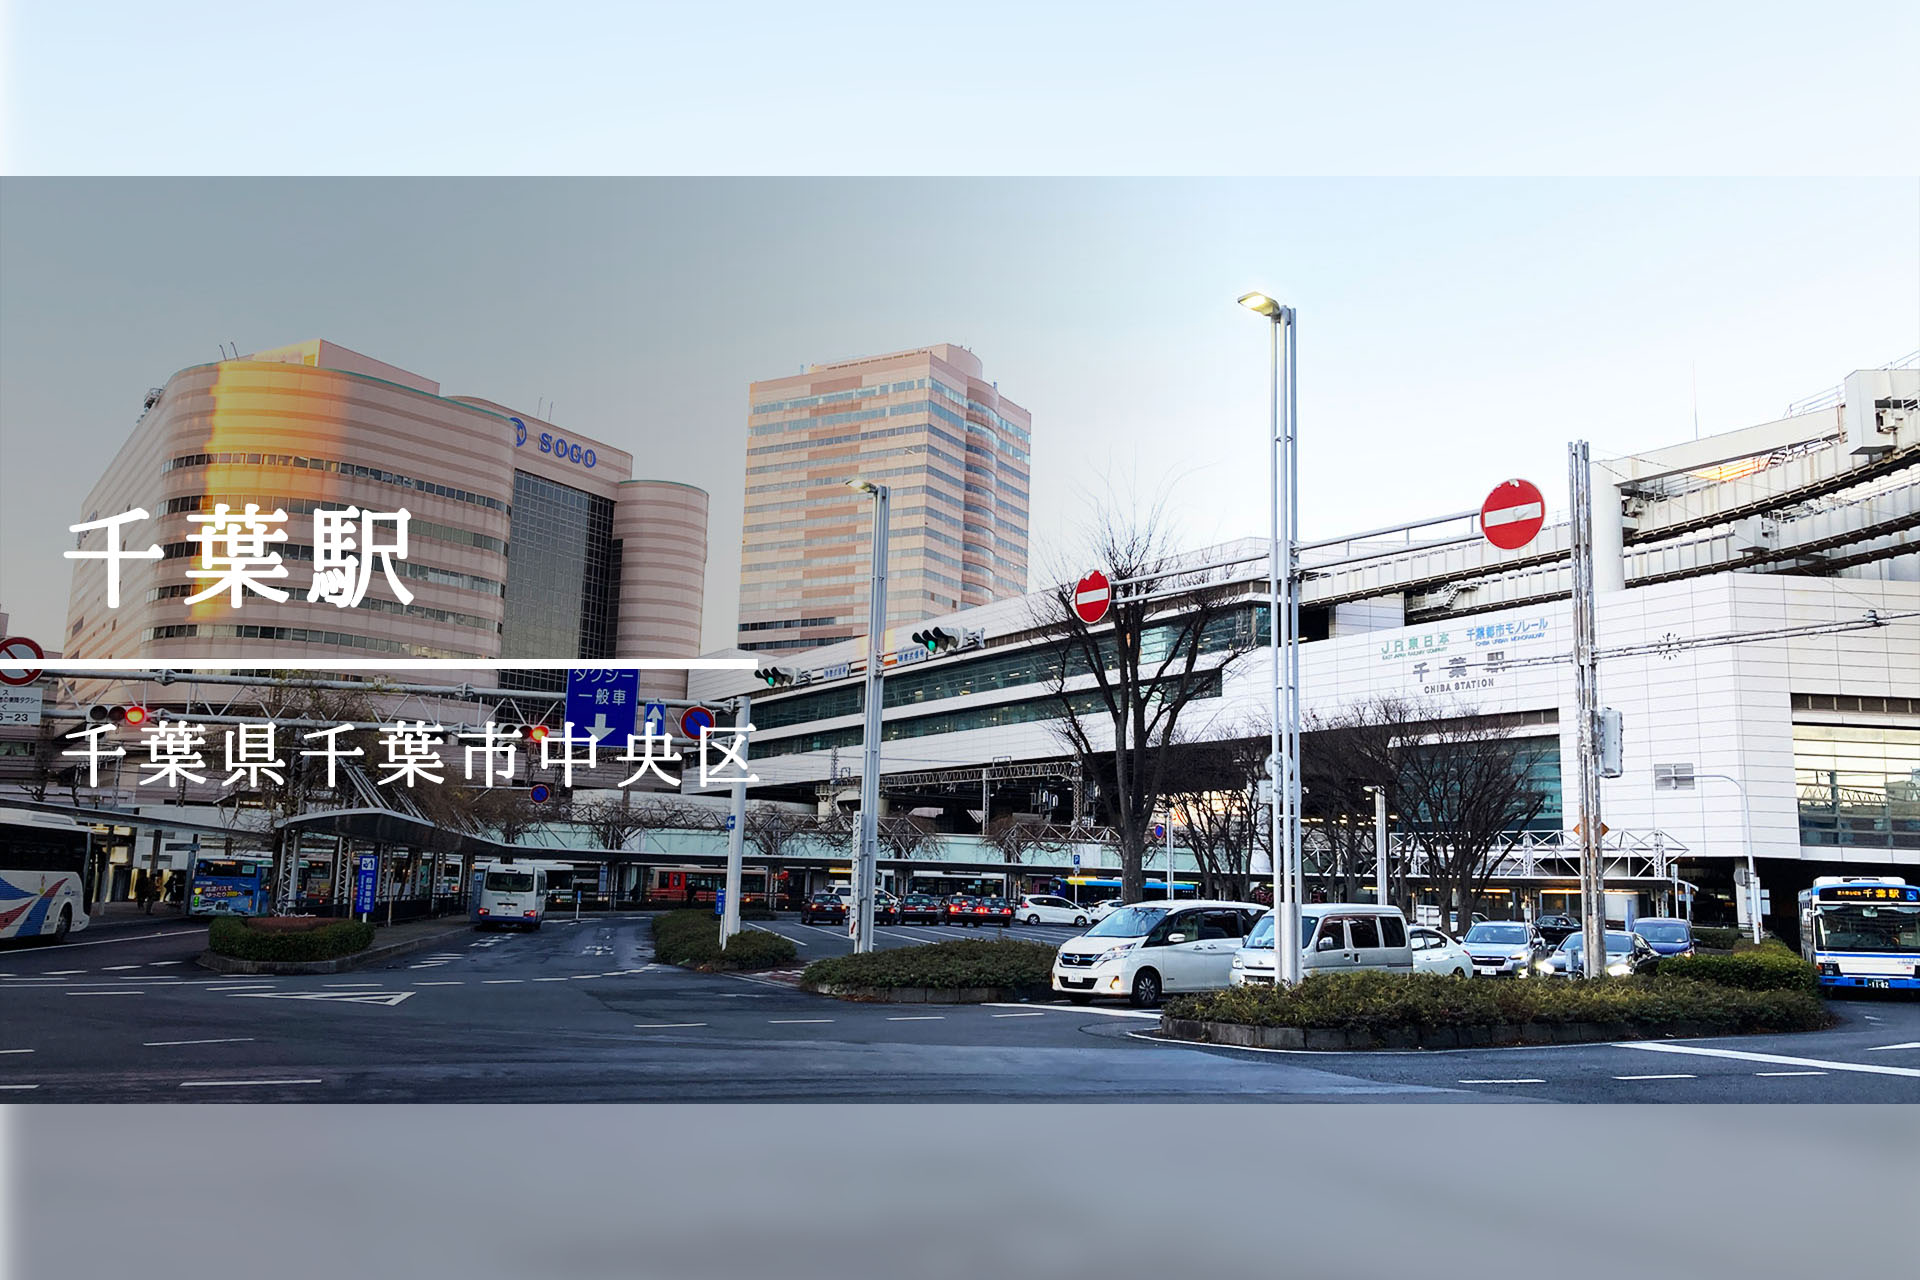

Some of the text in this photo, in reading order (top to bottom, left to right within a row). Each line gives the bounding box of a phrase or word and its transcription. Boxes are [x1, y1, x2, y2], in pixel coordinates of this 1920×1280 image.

[540, 432, 597, 468] SOGO
[1466, 618, 1548, 641] 千葉都市モノレール
[1381, 632, 1449, 654] JR東日本
[574, 669, 634, 683] タクシー
[1424, 678, 1495, 694] CHIBA STATION
[578, 688, 626, 706] 一般車
